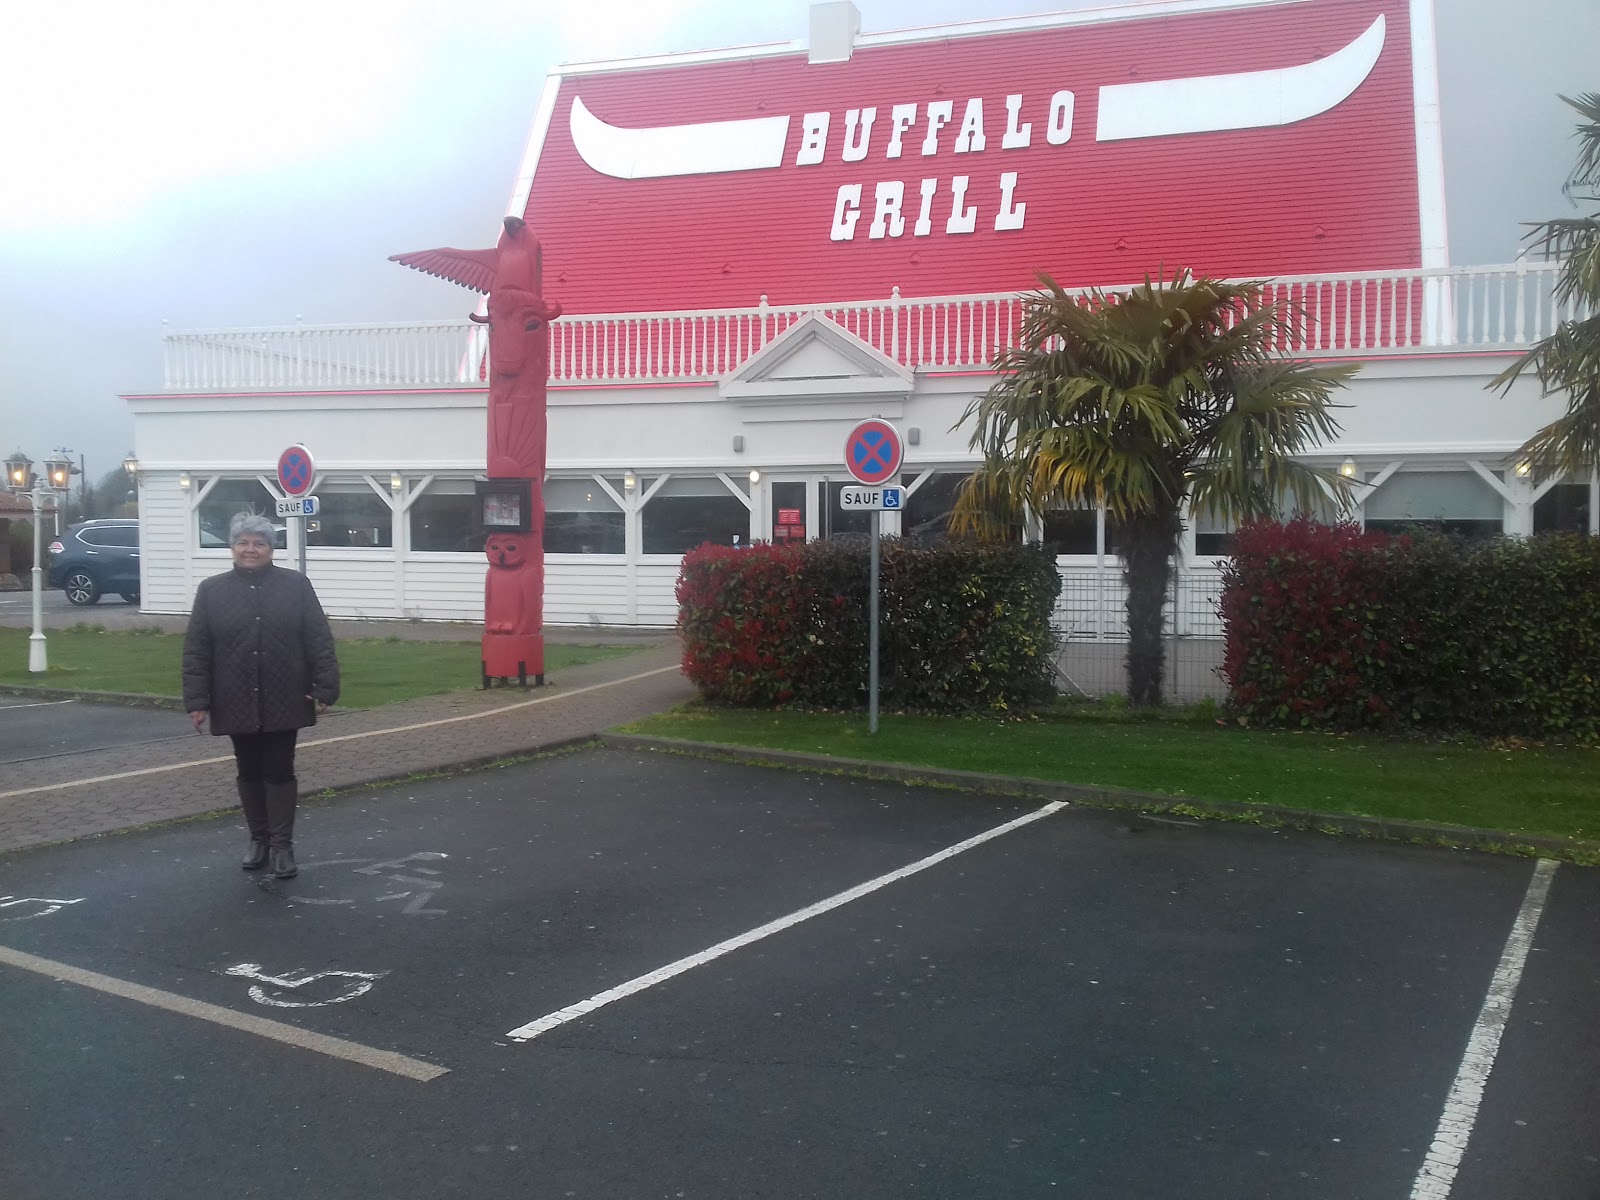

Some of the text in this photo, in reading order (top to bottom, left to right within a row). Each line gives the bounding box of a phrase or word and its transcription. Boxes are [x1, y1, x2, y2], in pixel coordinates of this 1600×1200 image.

[796, 90, 1075, 166] BUFFALO
[830, 172, 1026, 241] GRILL
[278, 503, 300, 513] SAUF
[845, 493, 878, 504] SAUF
